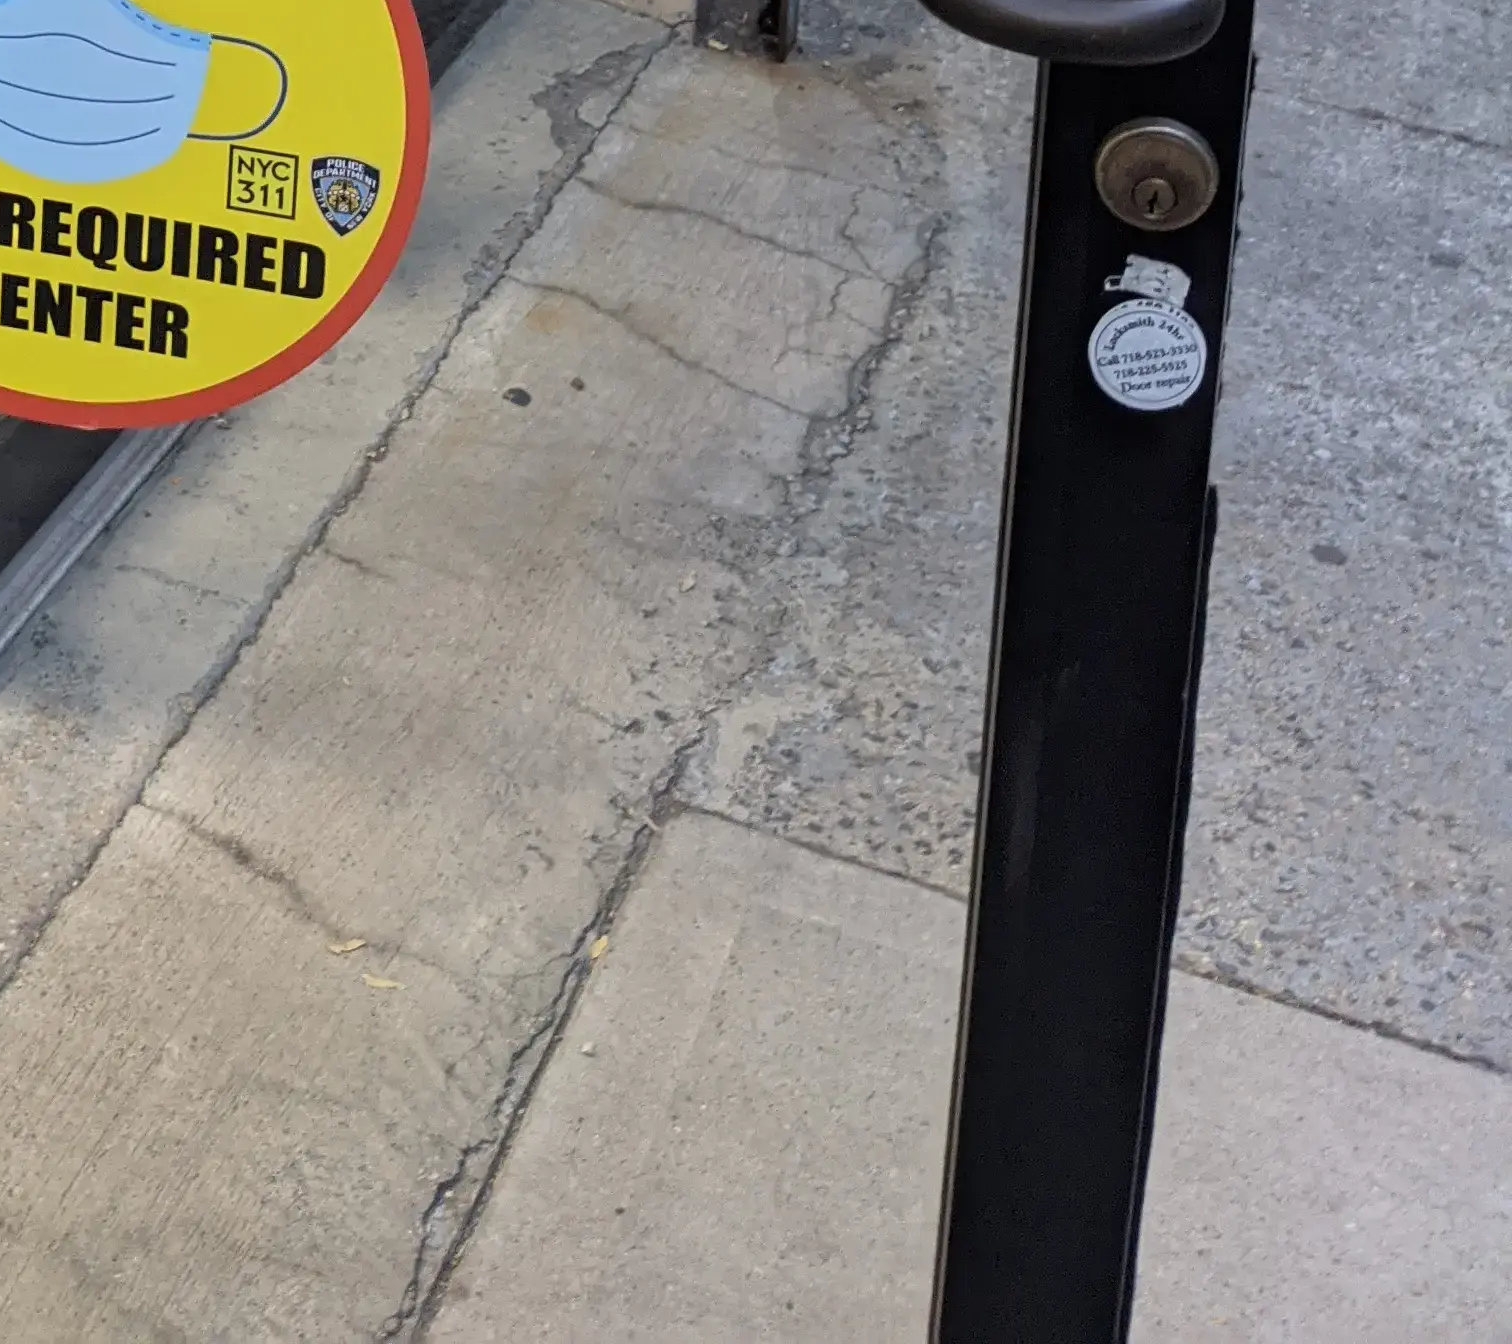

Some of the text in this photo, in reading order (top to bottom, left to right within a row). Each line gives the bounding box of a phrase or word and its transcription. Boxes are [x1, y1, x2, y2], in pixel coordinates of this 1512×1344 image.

[238, 155, 291, 182] NYC
[326, 158, 366, 173] POLICE
[313, 167, 377, 189] DEPARTMENT
[236, 179, 285, 210] 311
[0, 273, 189, 359] ENTER
[1103, 315, 1155, 352] Locksmith
[1158, 319, 1185, 341] 24hr
[1096, 354, 1120, 368] Call
[1120, 375, 1191, 394] Door repair
